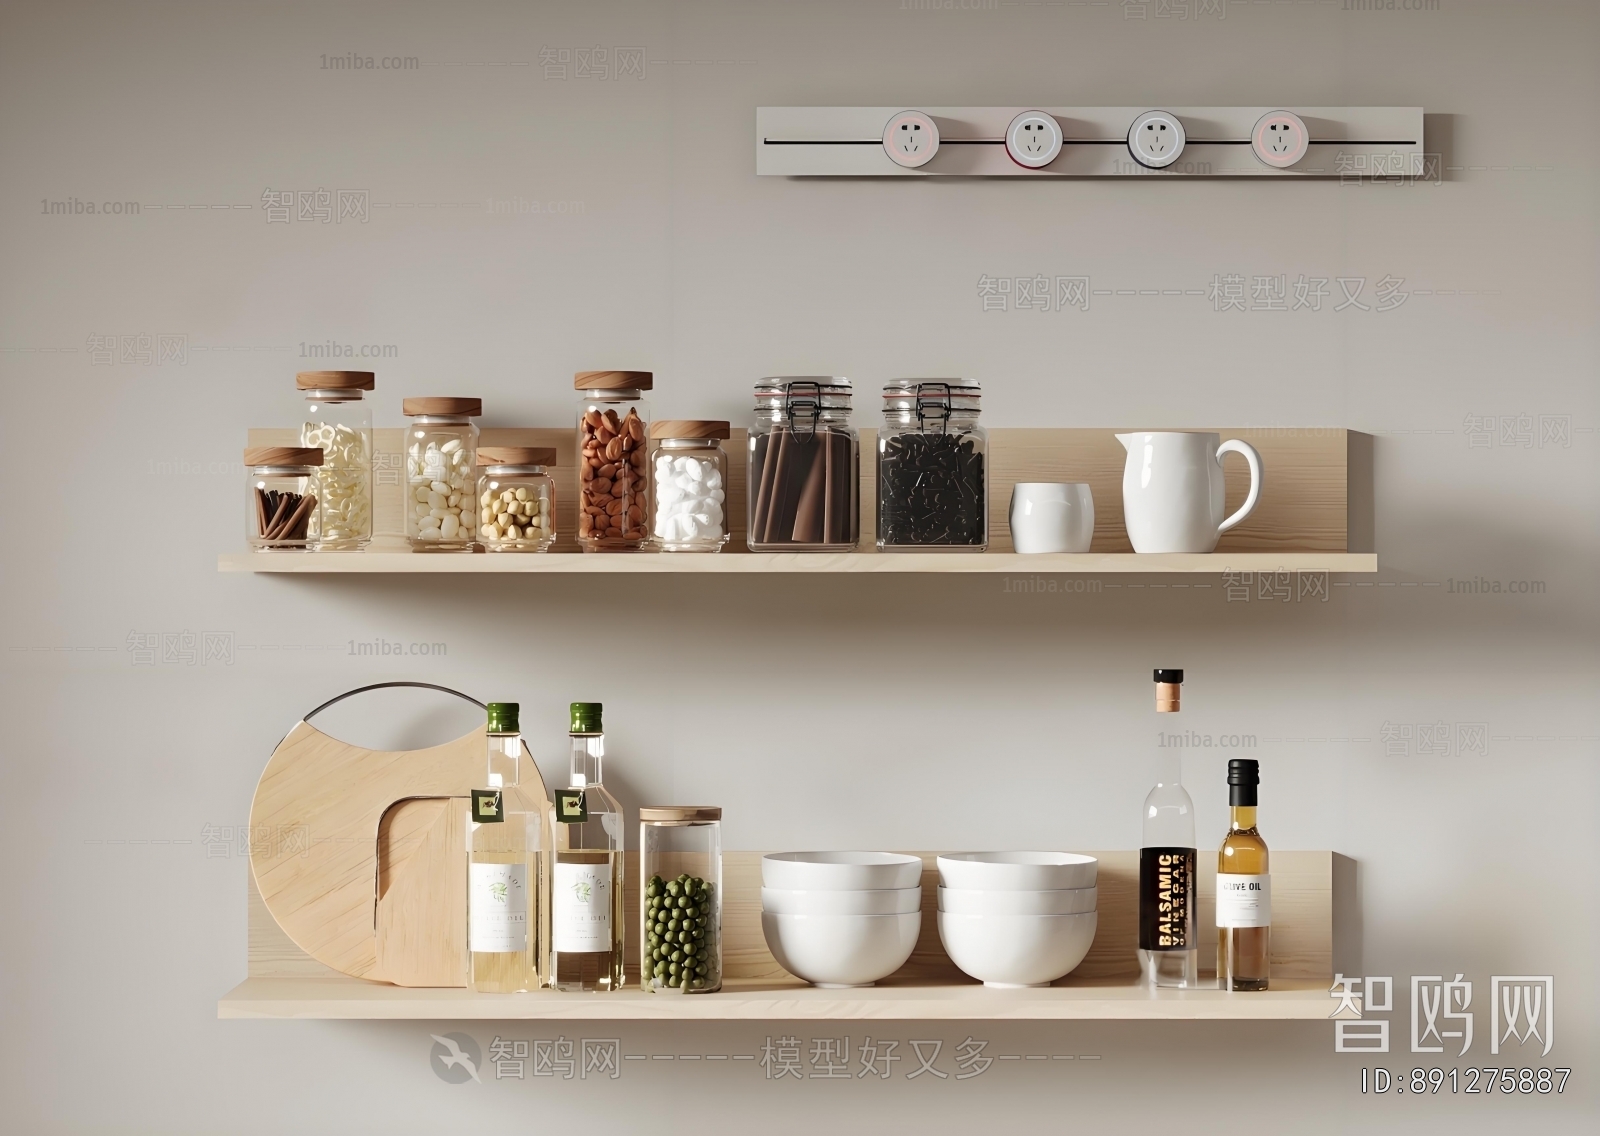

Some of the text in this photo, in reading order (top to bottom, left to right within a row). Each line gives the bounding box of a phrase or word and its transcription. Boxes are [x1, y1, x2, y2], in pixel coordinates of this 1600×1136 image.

[1158, 854, 1172, 947] BALSAMIC
[1172, 854, 1180, 947] VINEGAR
[1248, 882, 1262, 891] OIL
